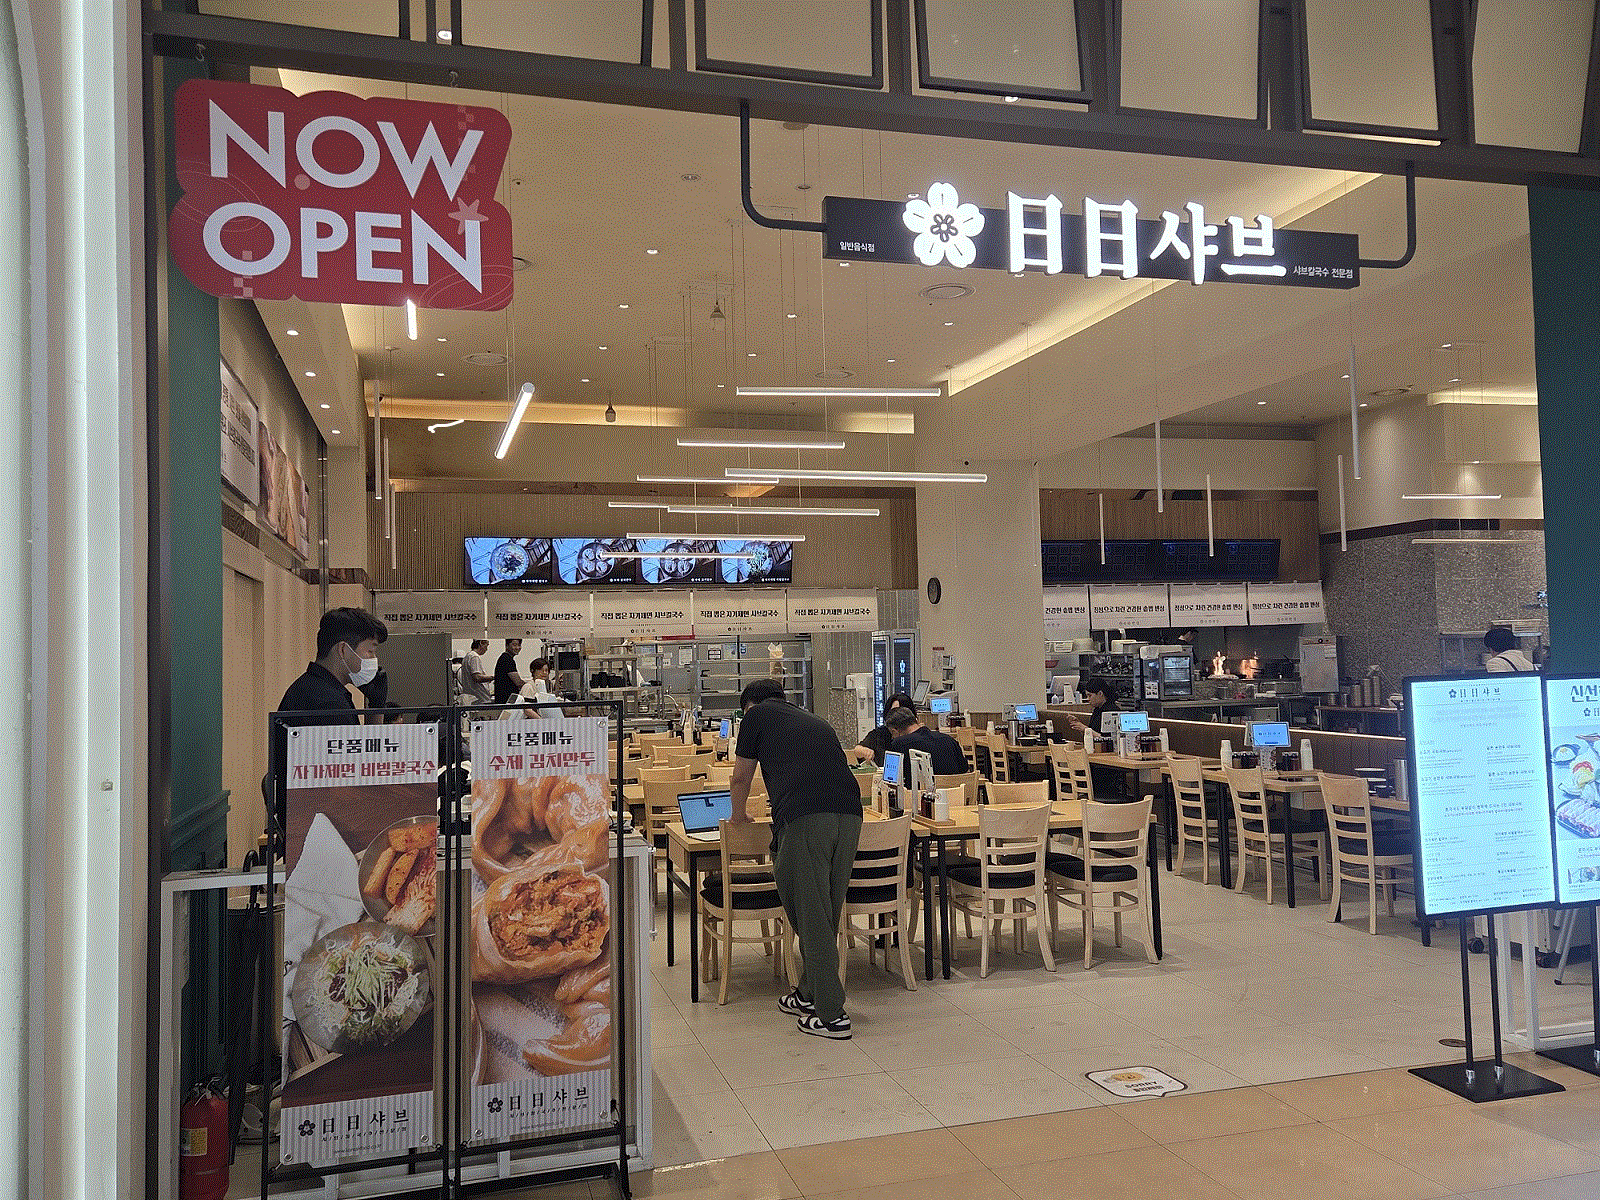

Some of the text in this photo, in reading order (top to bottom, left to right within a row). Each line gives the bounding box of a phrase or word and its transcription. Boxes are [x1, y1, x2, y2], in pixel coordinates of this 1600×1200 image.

[209, 98, 485, 202] NOW
[202, 201, 482, 294] OPEN
[839, 241, 875, 253] 일반음식점
[1007, 190, 1287, 285] 日日샤브
[1292, 265, 1354, 279] 샤브칼국수 전문점
[1570, 684, 1600, 703] 신선
[327, 738, 400, 754] 단품메뉴
[507, 731, 574, 747] 단품메뉴
[292, 760, 436, 780] 자가제면 비빔칼국수
[489, 751, 596, 771] 수제 김치만두
[509, 1086, 590, 1111] 日日샤브
[322, 1109, 410, 1135] 日日샤브
